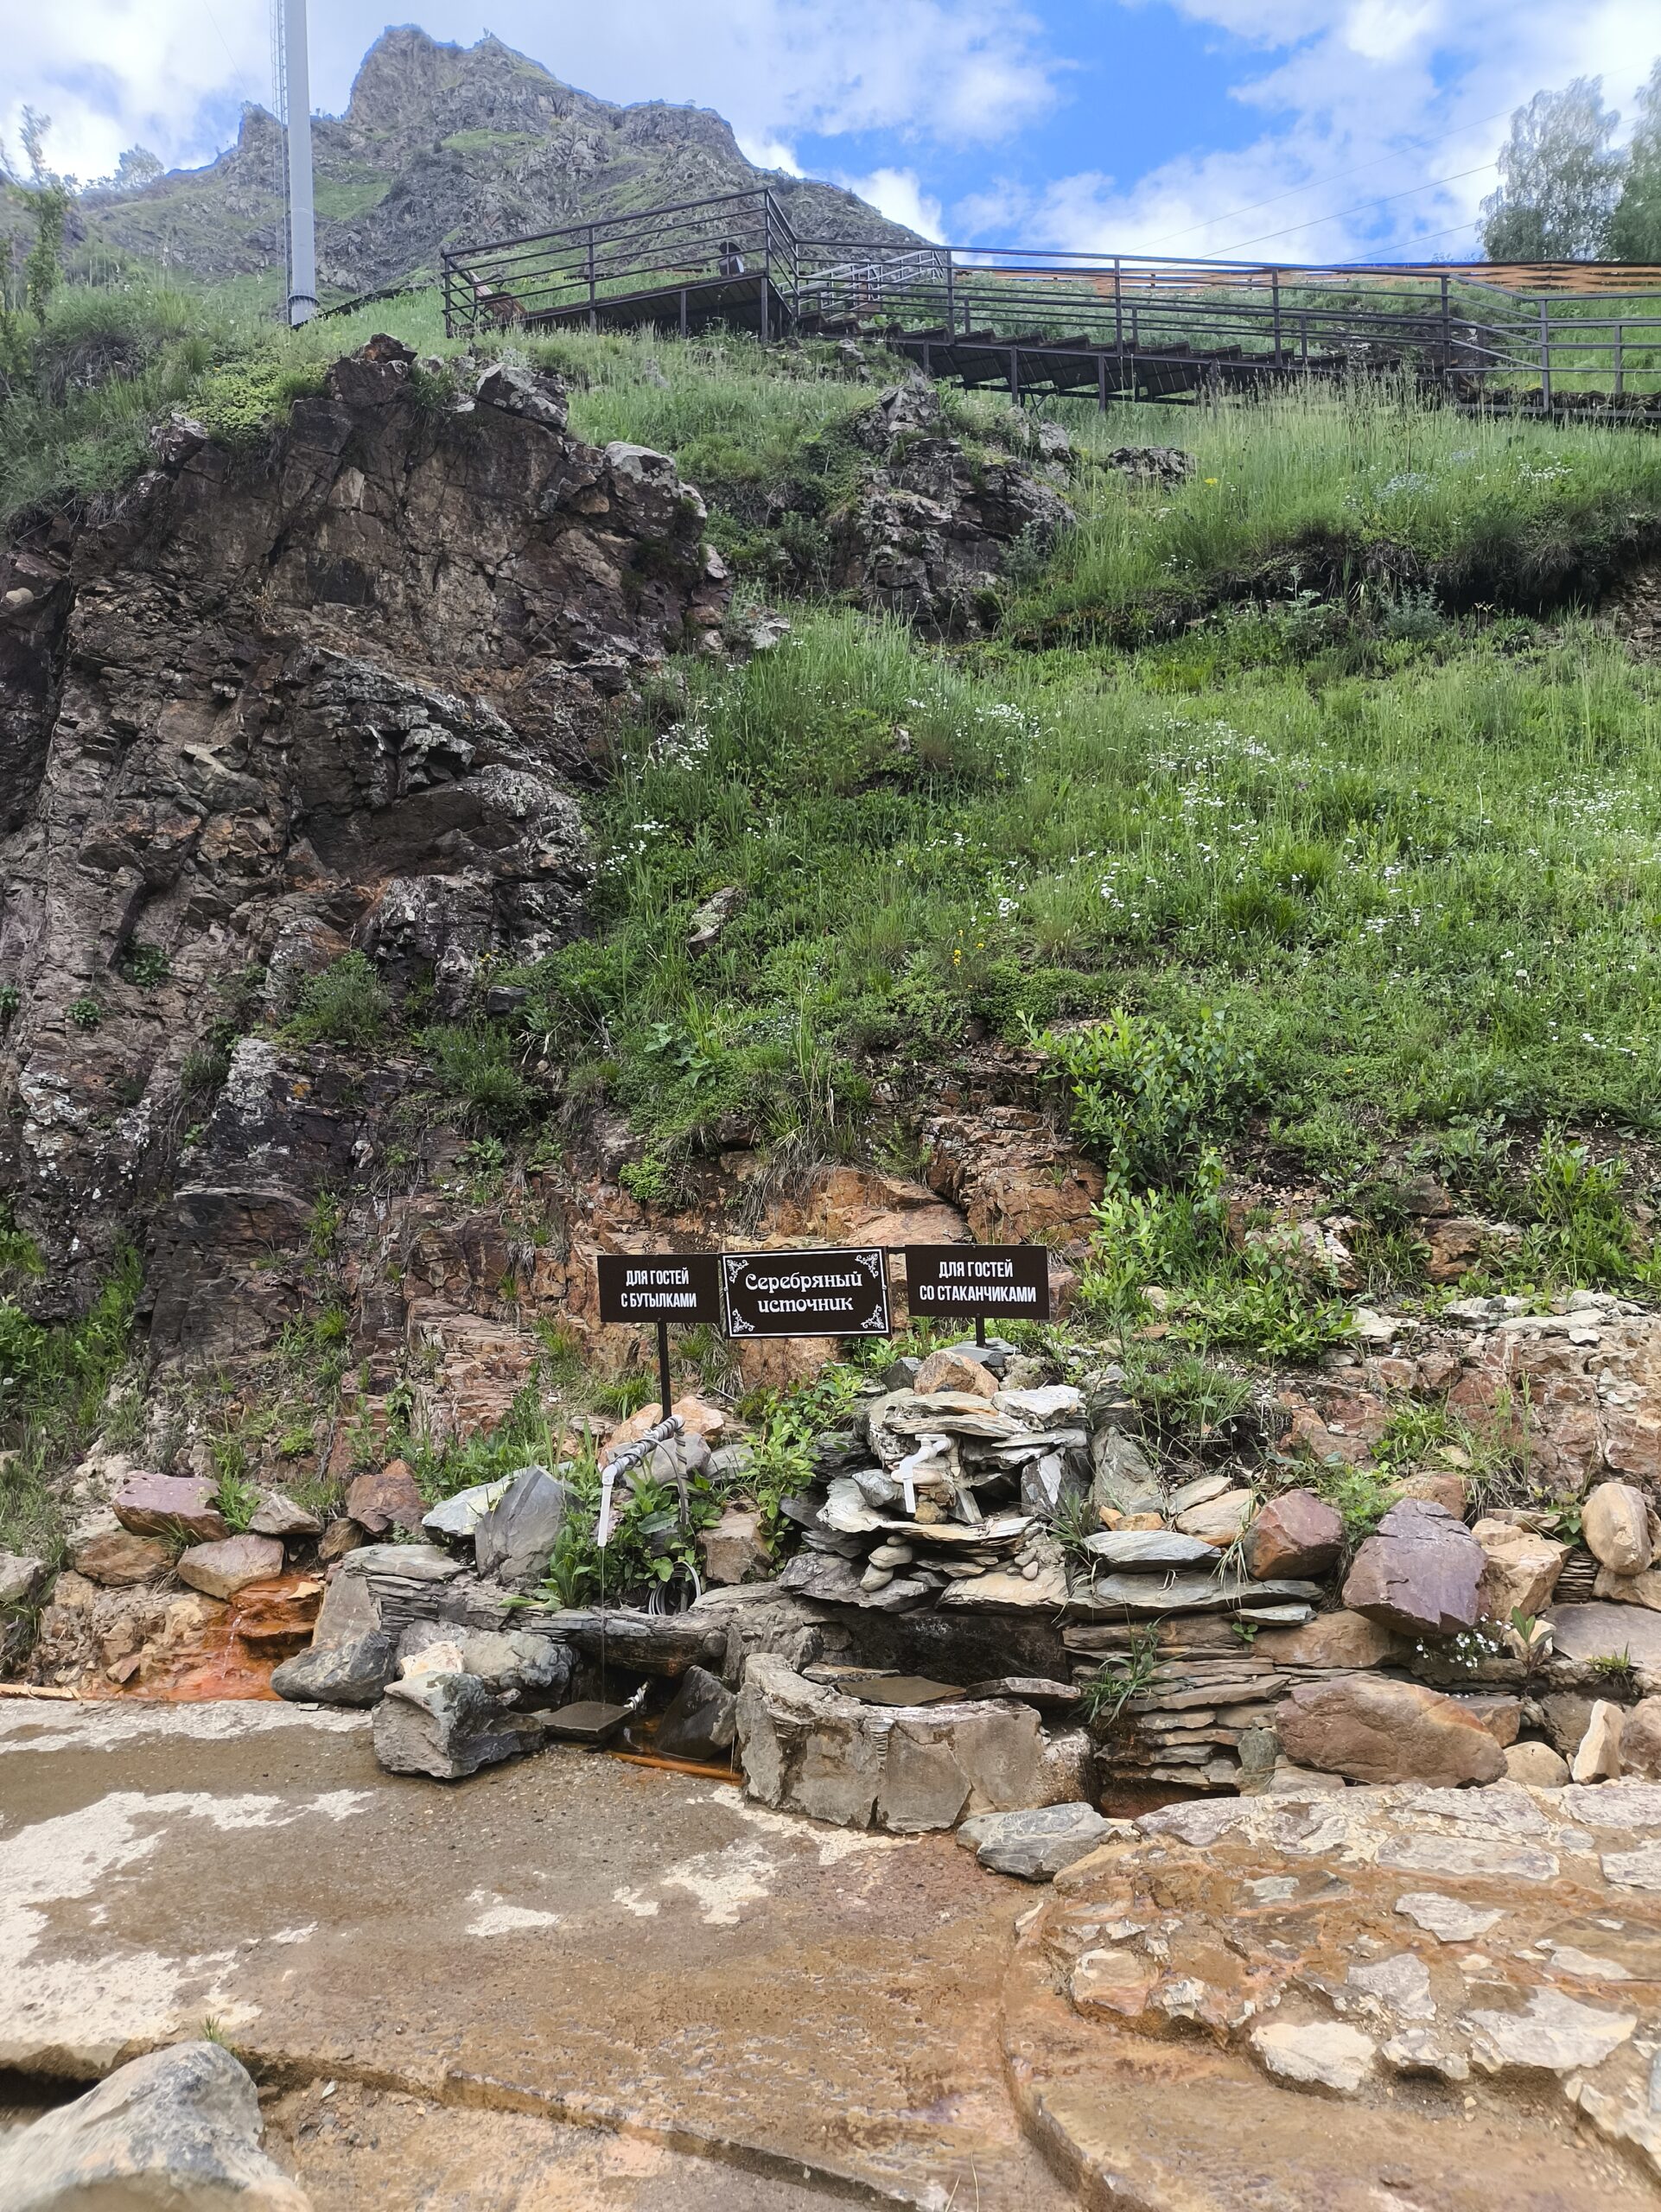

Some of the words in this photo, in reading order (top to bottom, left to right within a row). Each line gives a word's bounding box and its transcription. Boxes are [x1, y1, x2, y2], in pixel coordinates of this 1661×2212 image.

[626, 1270, 648, 1287] ДЛЯ
[650, 1267, 690, 1285] ГОСТЕЙ
[939, 1261, 965, 1279] ДЛЯ
[967, 1259, 1014, 1278] ГОСТЕЙ
[745, 1271, 863, 1294] Серебряный
[620, 1293, 628, 1308] С
[630, 1293, 697, 1308] БУТЫЛКАМИ
[919, 1285, 935, 1301] СО
[937, 1285, 1037, 1303] СТАКАНЧИКАМИ
[757, 1297, 855, 1313] источник
